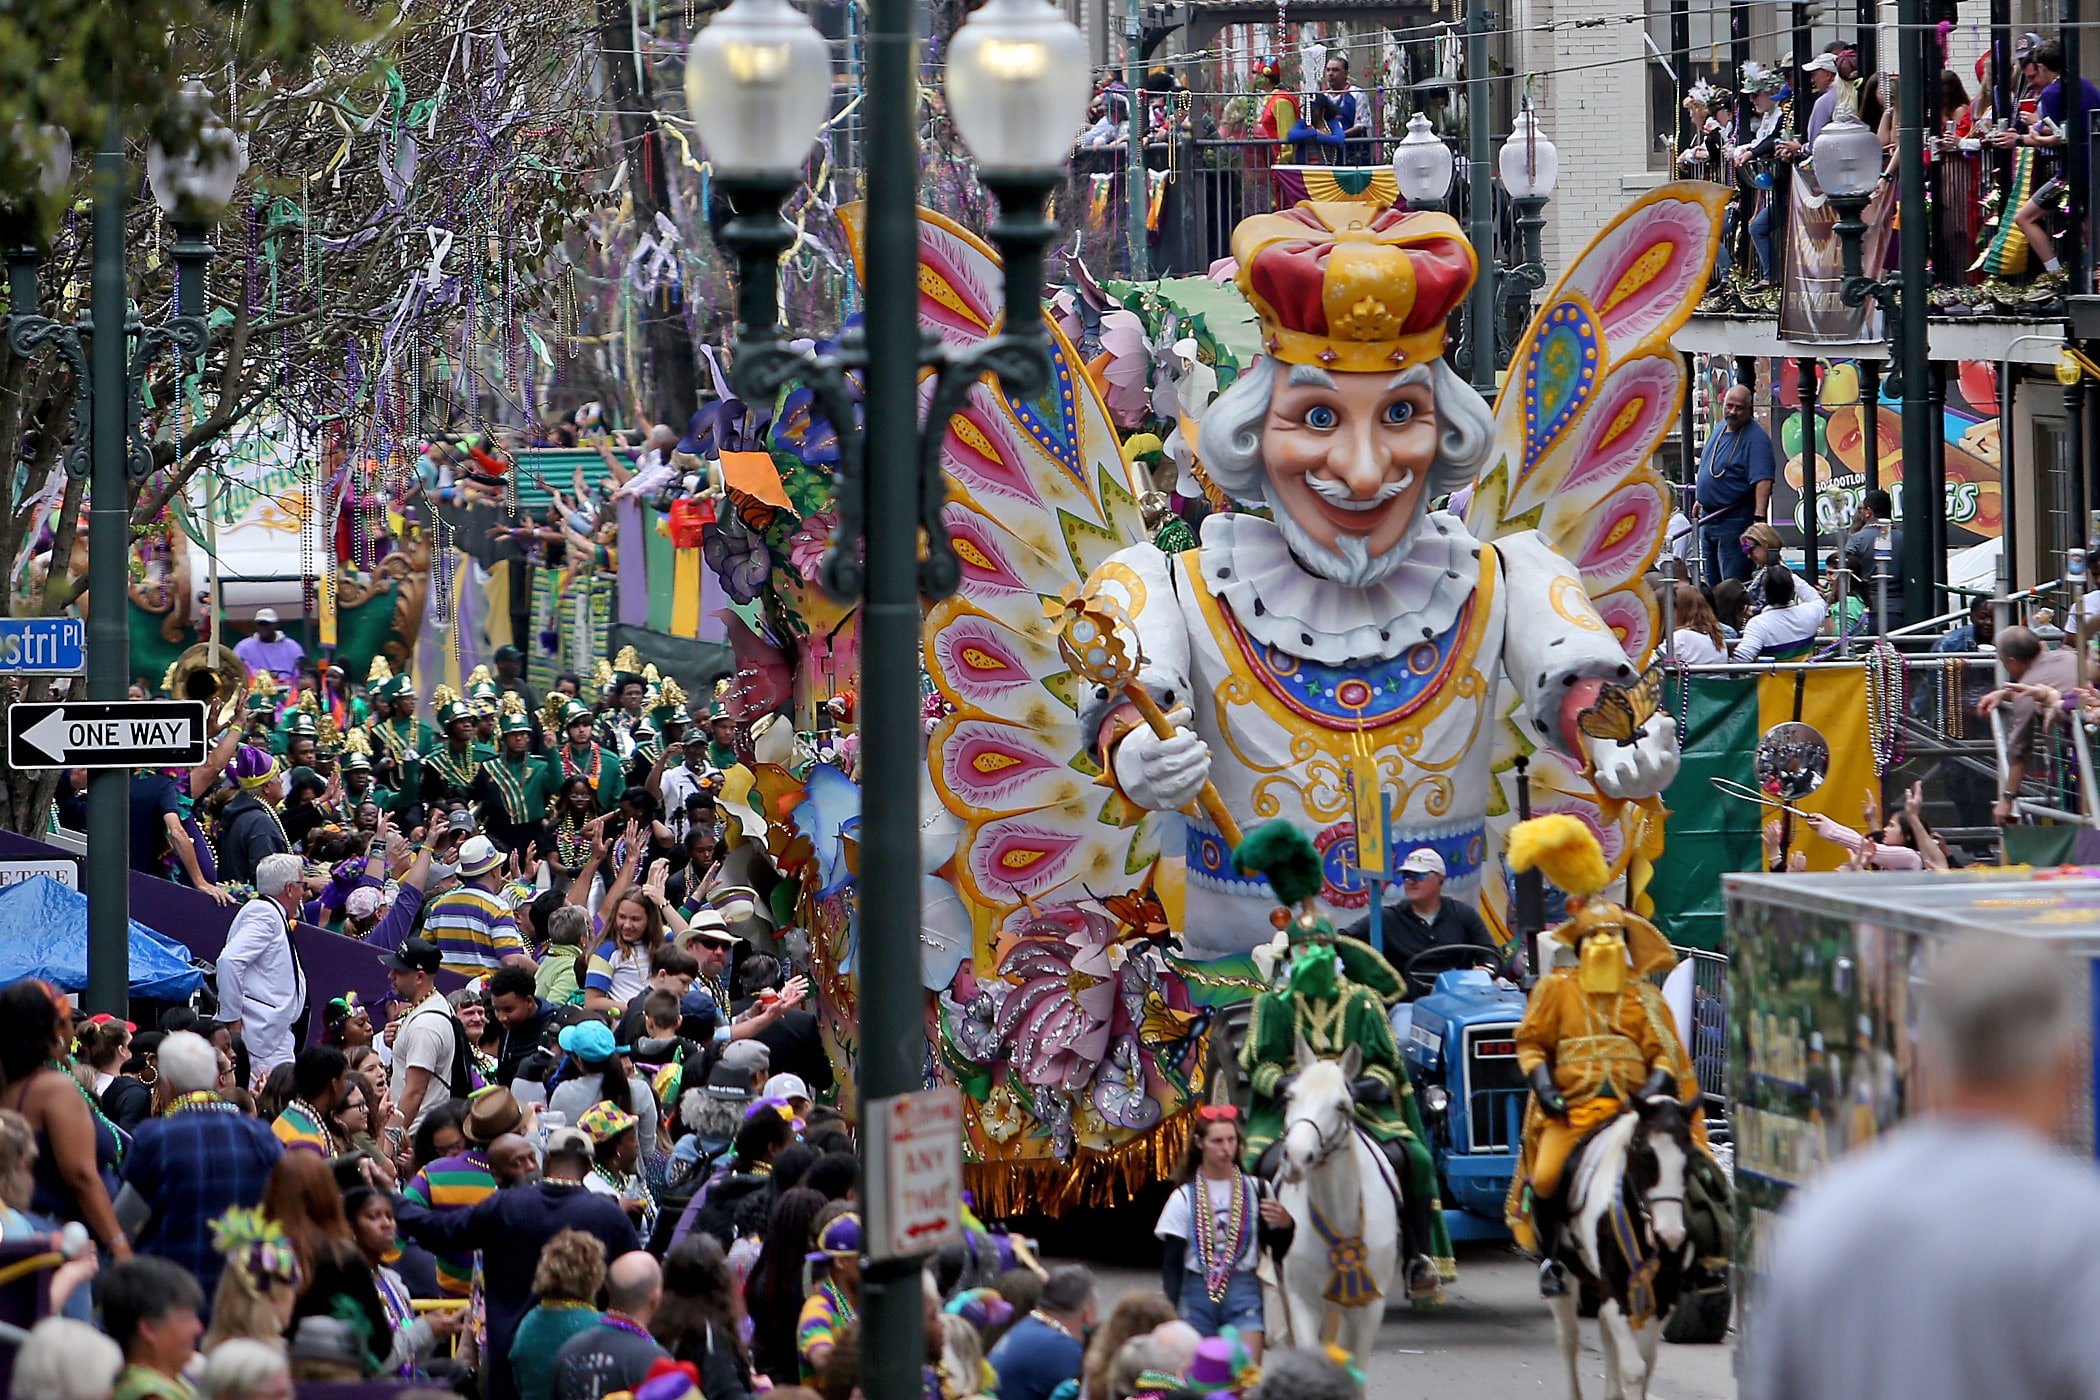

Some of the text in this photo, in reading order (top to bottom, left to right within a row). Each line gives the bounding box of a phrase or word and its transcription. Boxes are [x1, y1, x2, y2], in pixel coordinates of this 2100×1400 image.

[1797, 473, 1866, 500] JBO FOOTLON
[1890, 482, 1977, 520] DGS
[0, 624, 57, 664] stri
[69, 722, 183, 747] ONE WAY
[1482, 1043, 1513, 1054] FO
[906, 1146, 944, 1174] ANY
